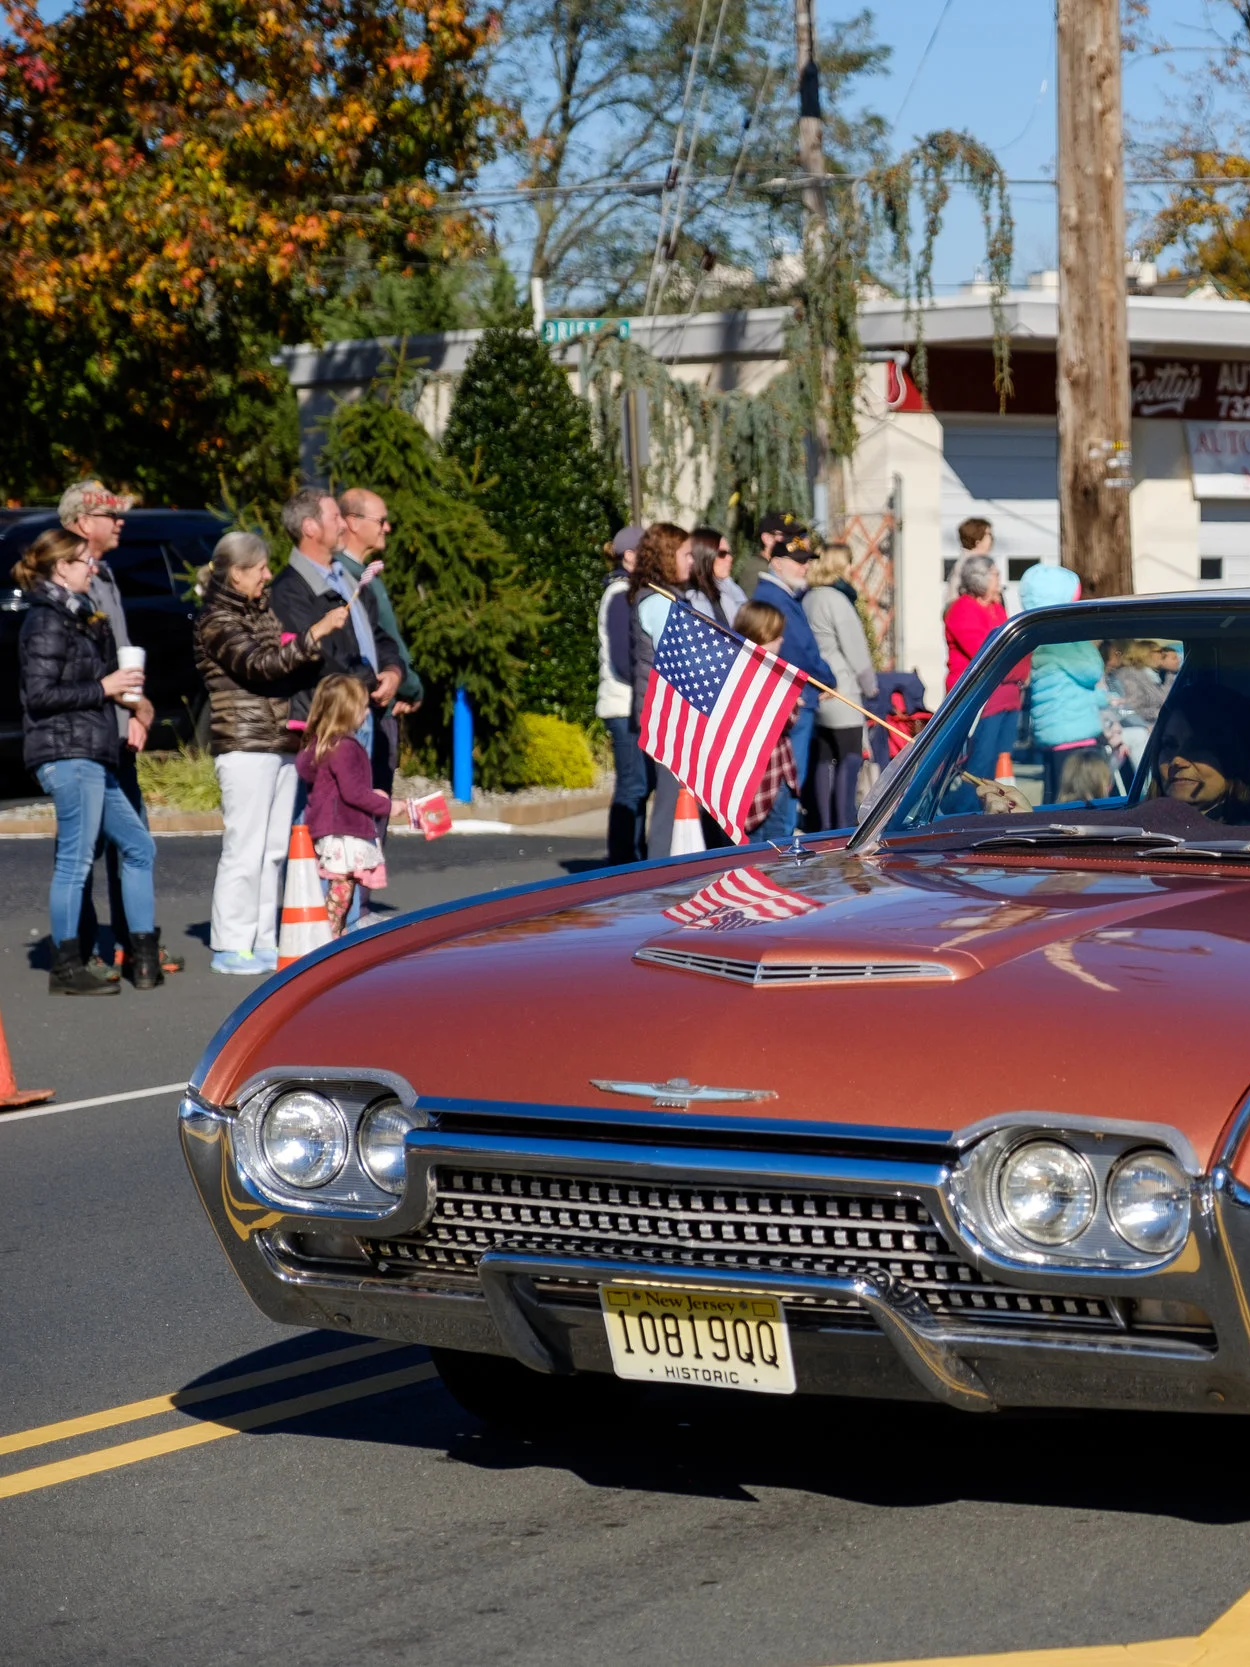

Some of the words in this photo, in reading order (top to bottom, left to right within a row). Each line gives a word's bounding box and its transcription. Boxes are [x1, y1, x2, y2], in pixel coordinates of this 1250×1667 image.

[644, 1291, 682, 1308] New
[686, 1295, 736, 1315] Jersey
[618, 1310, 780, 1369] 10819QQ
[665, 1365, 740, 1384] HISTORIC
